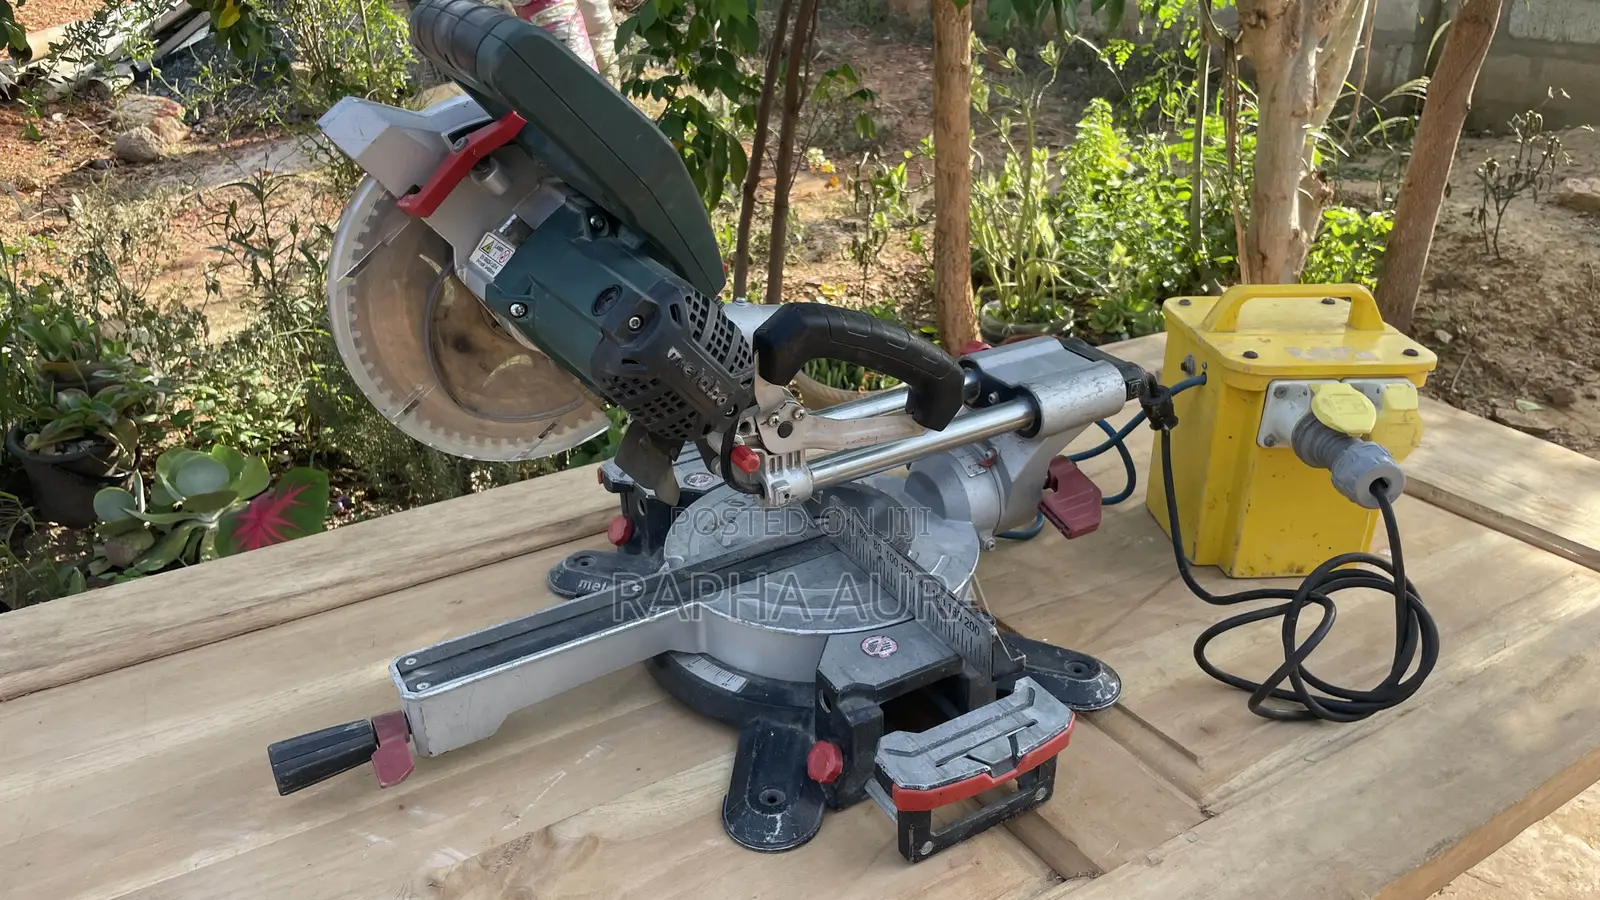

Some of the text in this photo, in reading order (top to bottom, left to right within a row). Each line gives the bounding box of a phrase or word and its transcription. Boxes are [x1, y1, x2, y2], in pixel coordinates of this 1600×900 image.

[667, 345, 728, 406] metabo
[577, 579, 609, 592] met
[860, 528, 868, 541] 60
[873, 539, 882, 553] 80
[886, 550, 899, 567] 100
[900, 562, 914, 580] 120
[964, 616, 980, 636] 200
